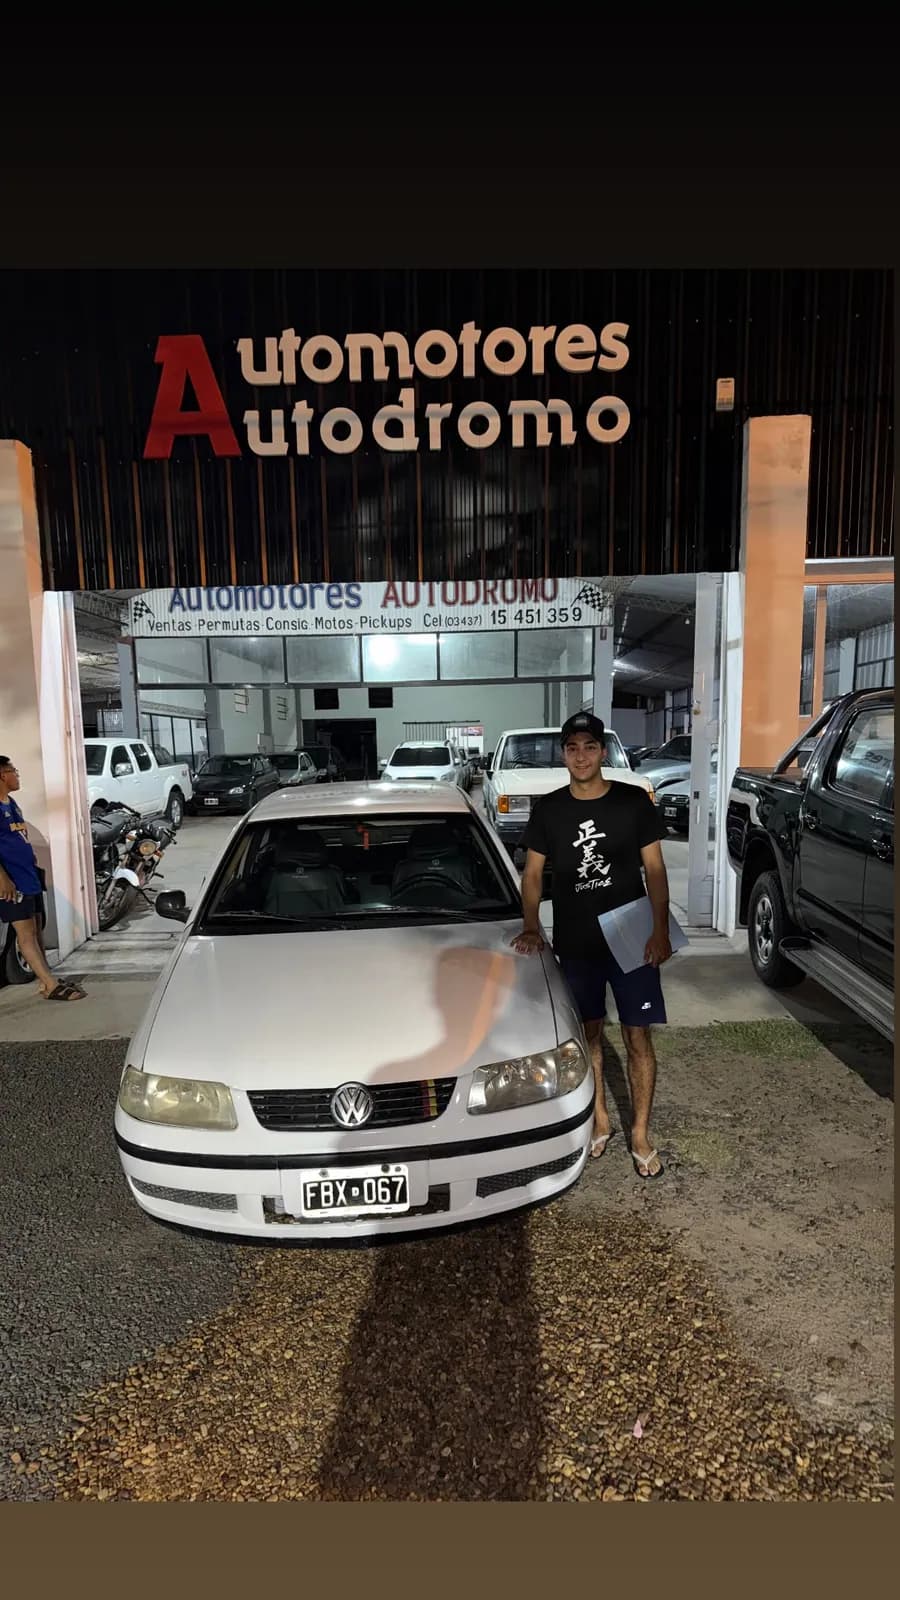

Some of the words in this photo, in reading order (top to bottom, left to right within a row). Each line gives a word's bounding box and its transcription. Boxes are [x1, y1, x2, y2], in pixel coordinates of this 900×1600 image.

[169, 582, 362, 612] Automotores
[381, 578, 559, 607] AUTODROMO
[148, 618, 192, 632] Ventas
[198, 617, 260, 631] Permutas
[315, 616, 353, 630] Motos
[360, 615, 412, 631] Pickups
[423, 613, 442, 628] Cel
[444, 615, 482, 628] (03437)
[490, 609, 507, 625] 15
[514, 609, 541, 624] 451
[547, 607, 582, 623] 359
